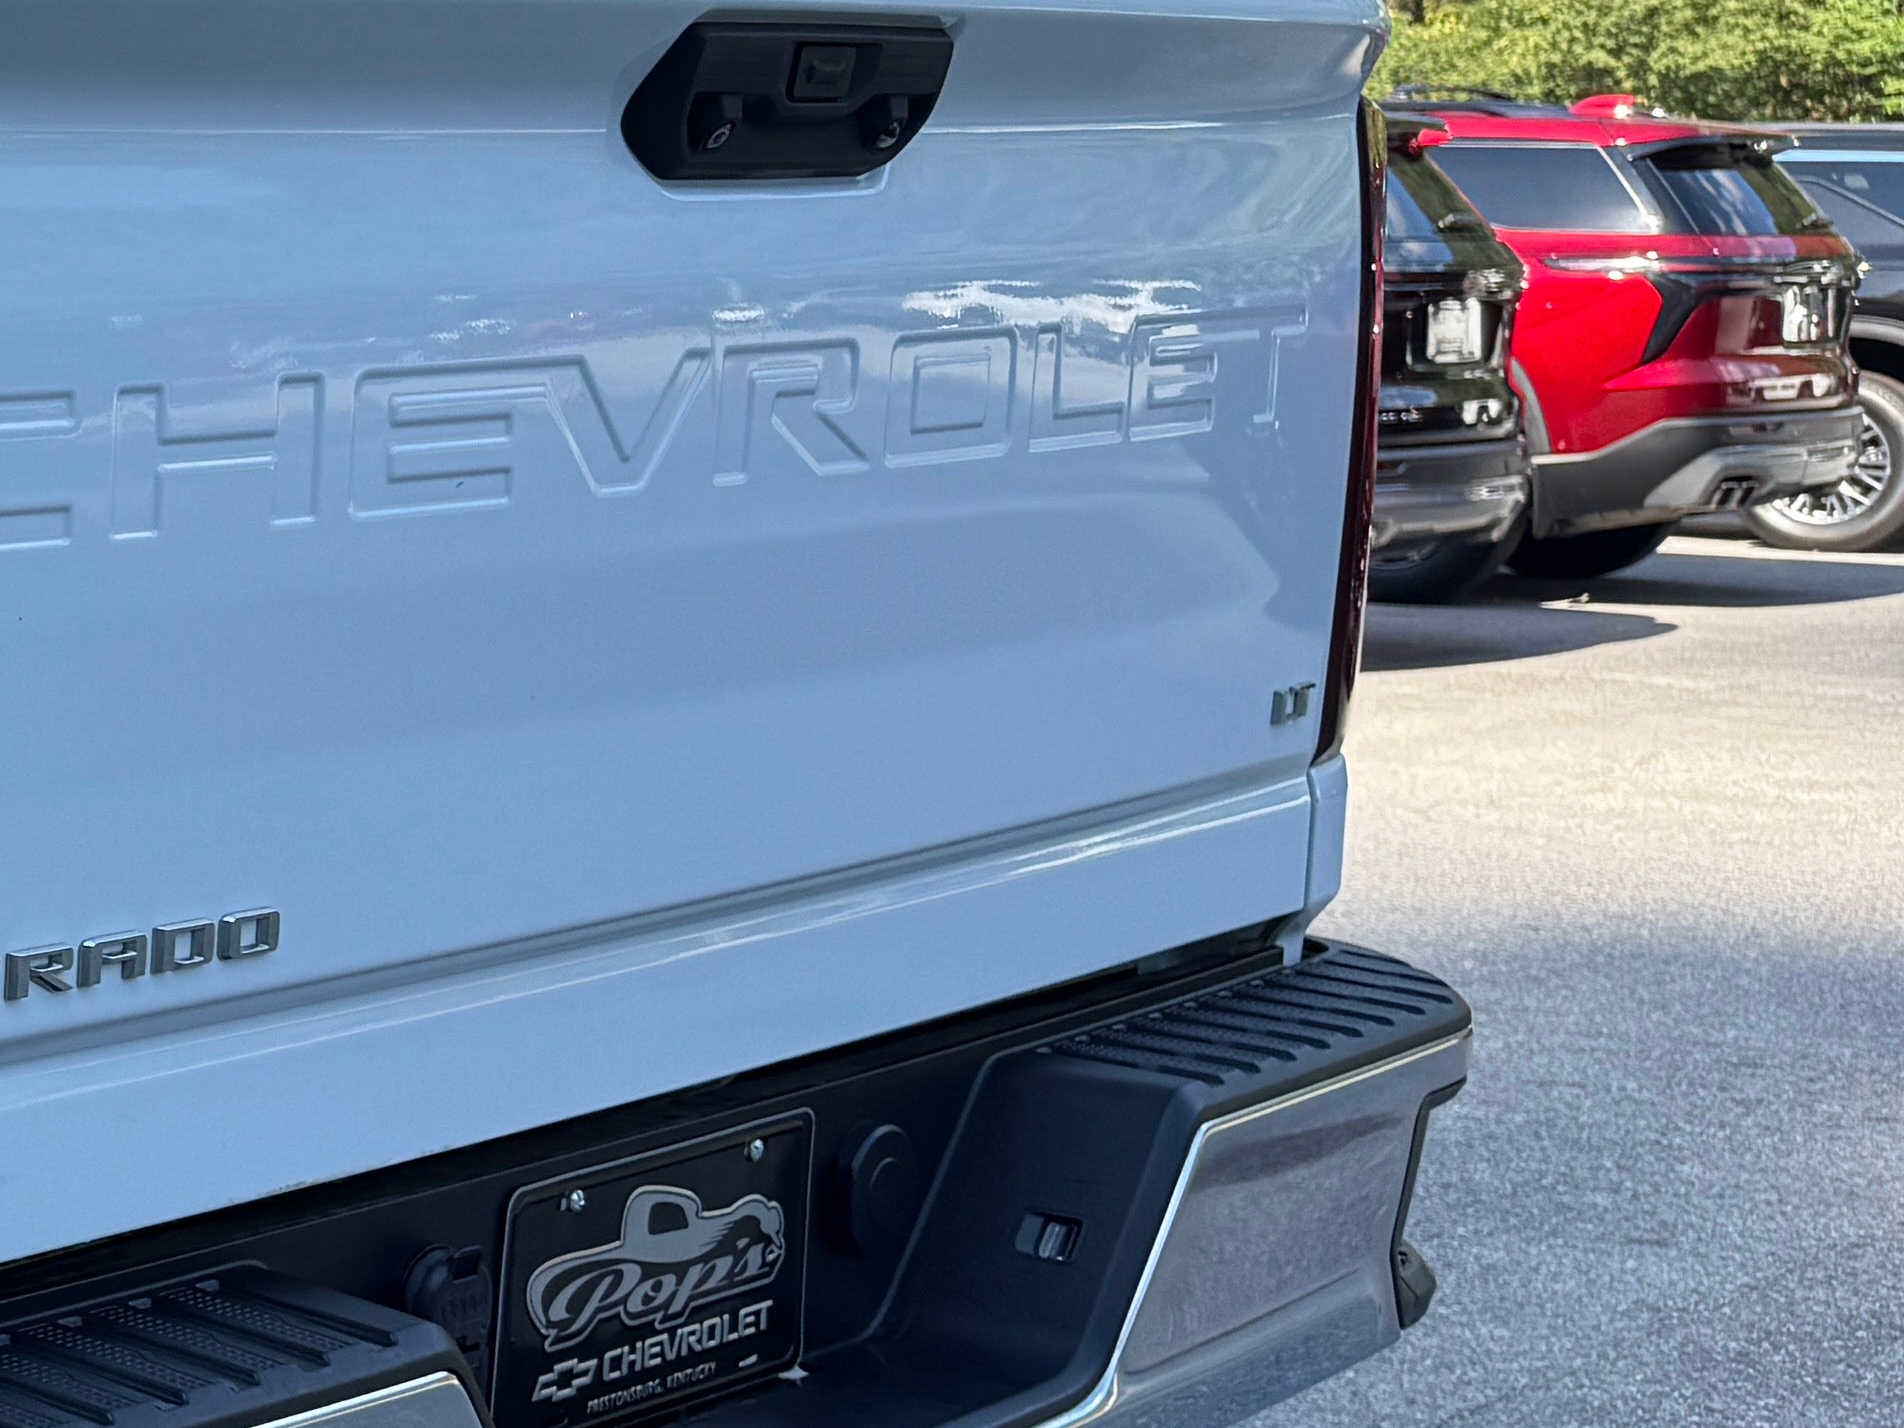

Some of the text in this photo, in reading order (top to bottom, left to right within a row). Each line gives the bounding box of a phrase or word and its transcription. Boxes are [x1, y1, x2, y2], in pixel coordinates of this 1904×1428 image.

[1270, 681, 1317, 727] LT
[547, 1236, 782, 1342] Pop's
[601, 1299, 774, 1382] CHEVROLET
